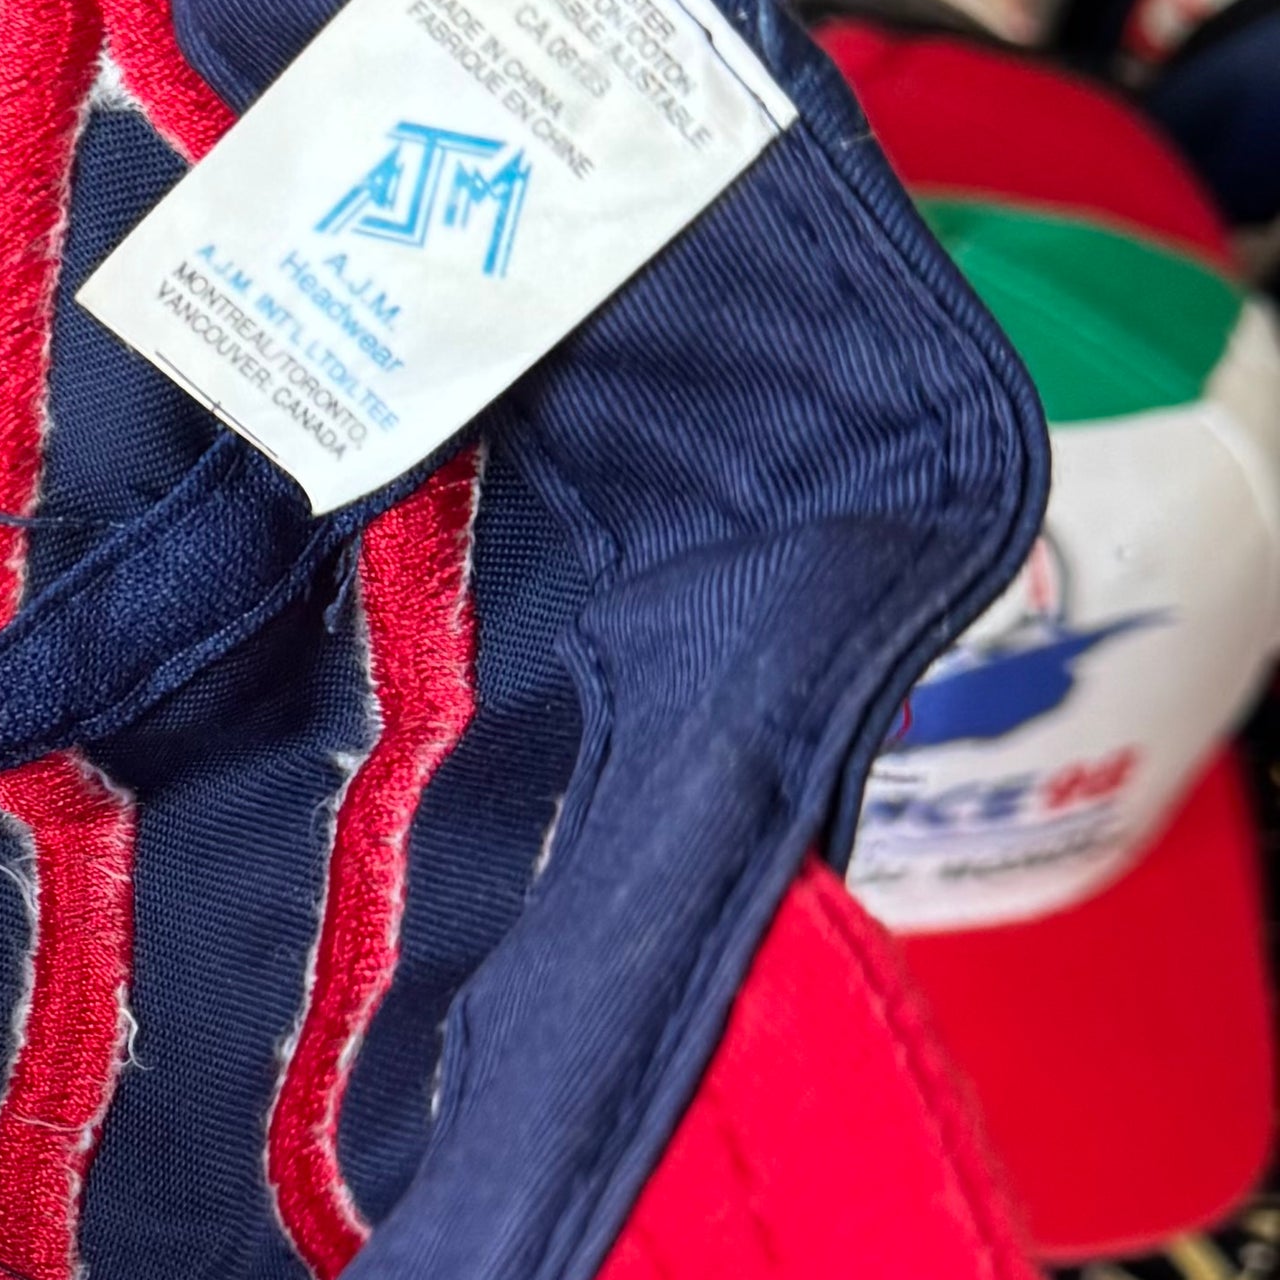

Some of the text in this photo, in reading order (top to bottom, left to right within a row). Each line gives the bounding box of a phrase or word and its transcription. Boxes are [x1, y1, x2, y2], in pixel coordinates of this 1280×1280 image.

[511, 1, 554, 44] CA
[478, 34, 507, 63] IN
[500, 54, 567, 120] CHINA
[499, 87, 536, 123] EN
[527, 113, 597, 182] CHINE
[276, 247, 409, 377] Headwear
[319, 244, 410, 333] A.J.M.
[268, 383, 352, 463] CANADA
